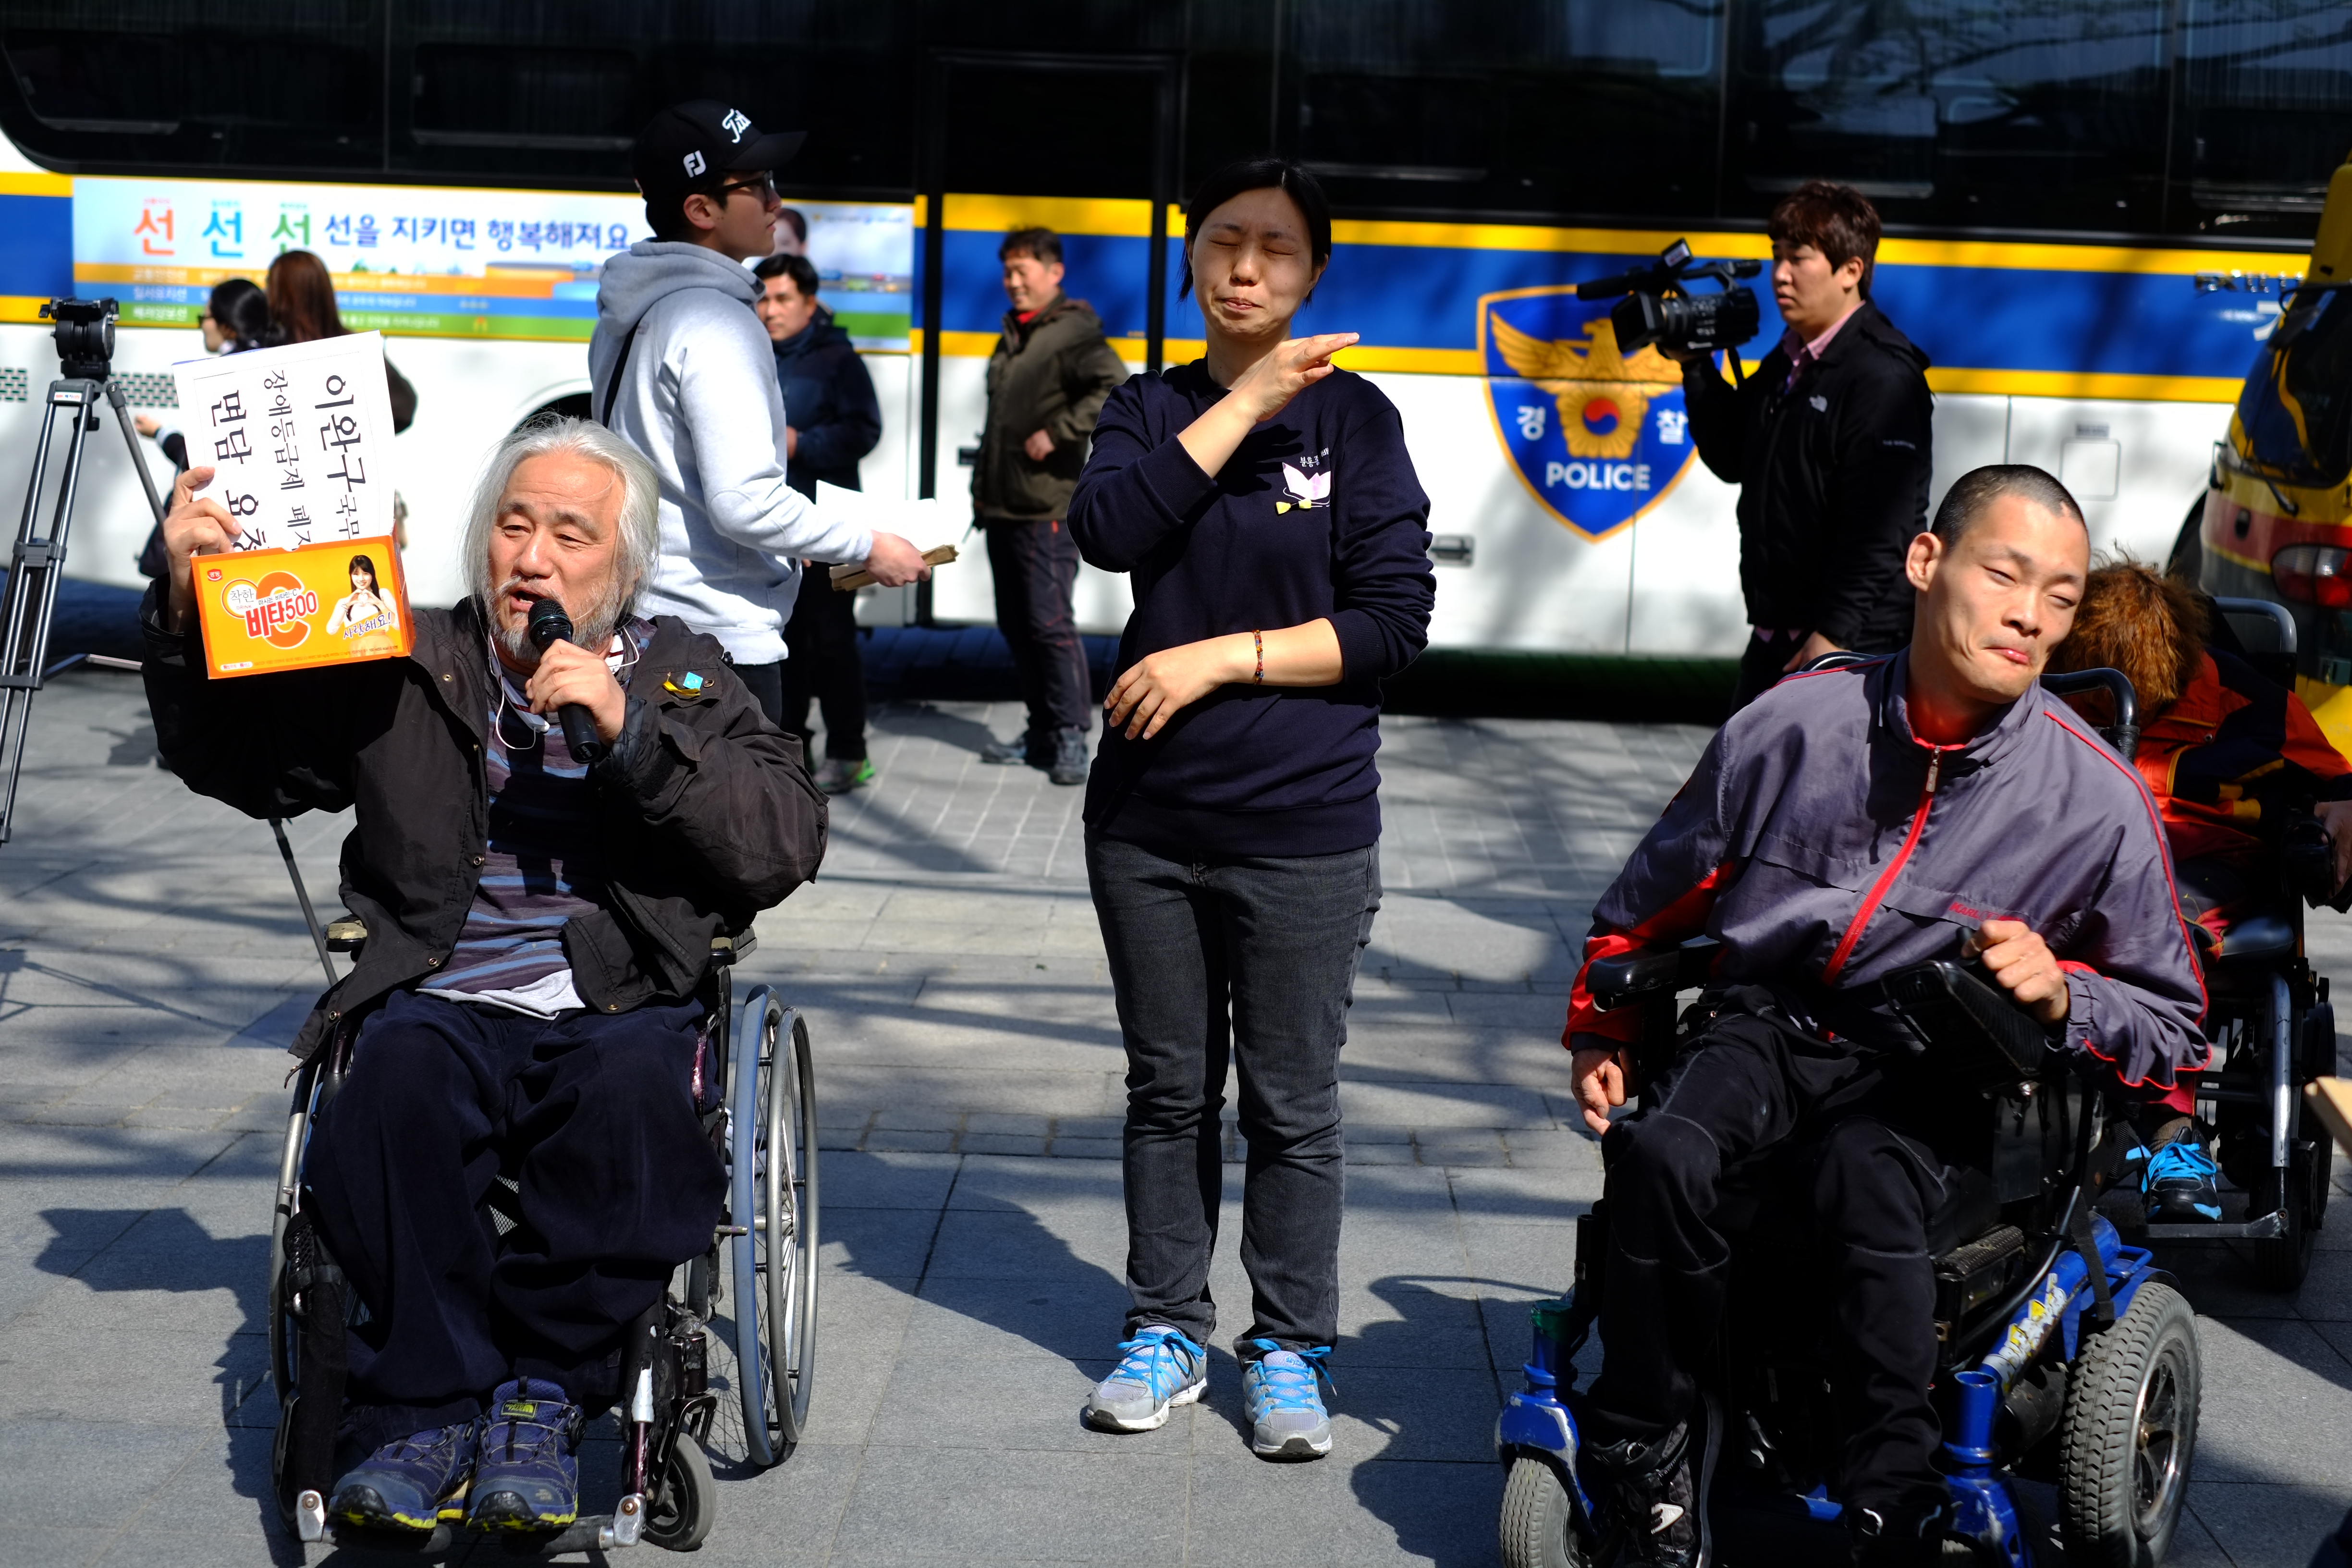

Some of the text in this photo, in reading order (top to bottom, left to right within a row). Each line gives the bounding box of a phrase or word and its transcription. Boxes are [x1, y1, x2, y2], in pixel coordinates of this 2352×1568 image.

[683, 150, 706, 178] FJ
[135, 208, 175, 256] 선
[202, 211, 244, 258] 선
[325, 214, 381, 247] 선을
[392, 216, 477, 250] 지키면
[487, 219, 631, 252] 행복해져요
[211, 389, 252, 465] 면담
[264, 369, 305, 490] 장애등급제
[1517, 405, 1546, 441] 경
[1299, 447, 1329, 467] 분홍종배
[1545, 461, 1651, 490] POLICE
[230, 588, 255, 604] 착한
[258, 598, 274, 606] 마시는
[245, 591, 317, 637] 비타500
[343, 612, 391, 639] 사랑해요!
[1949, 901, 1979, 919] KARL
